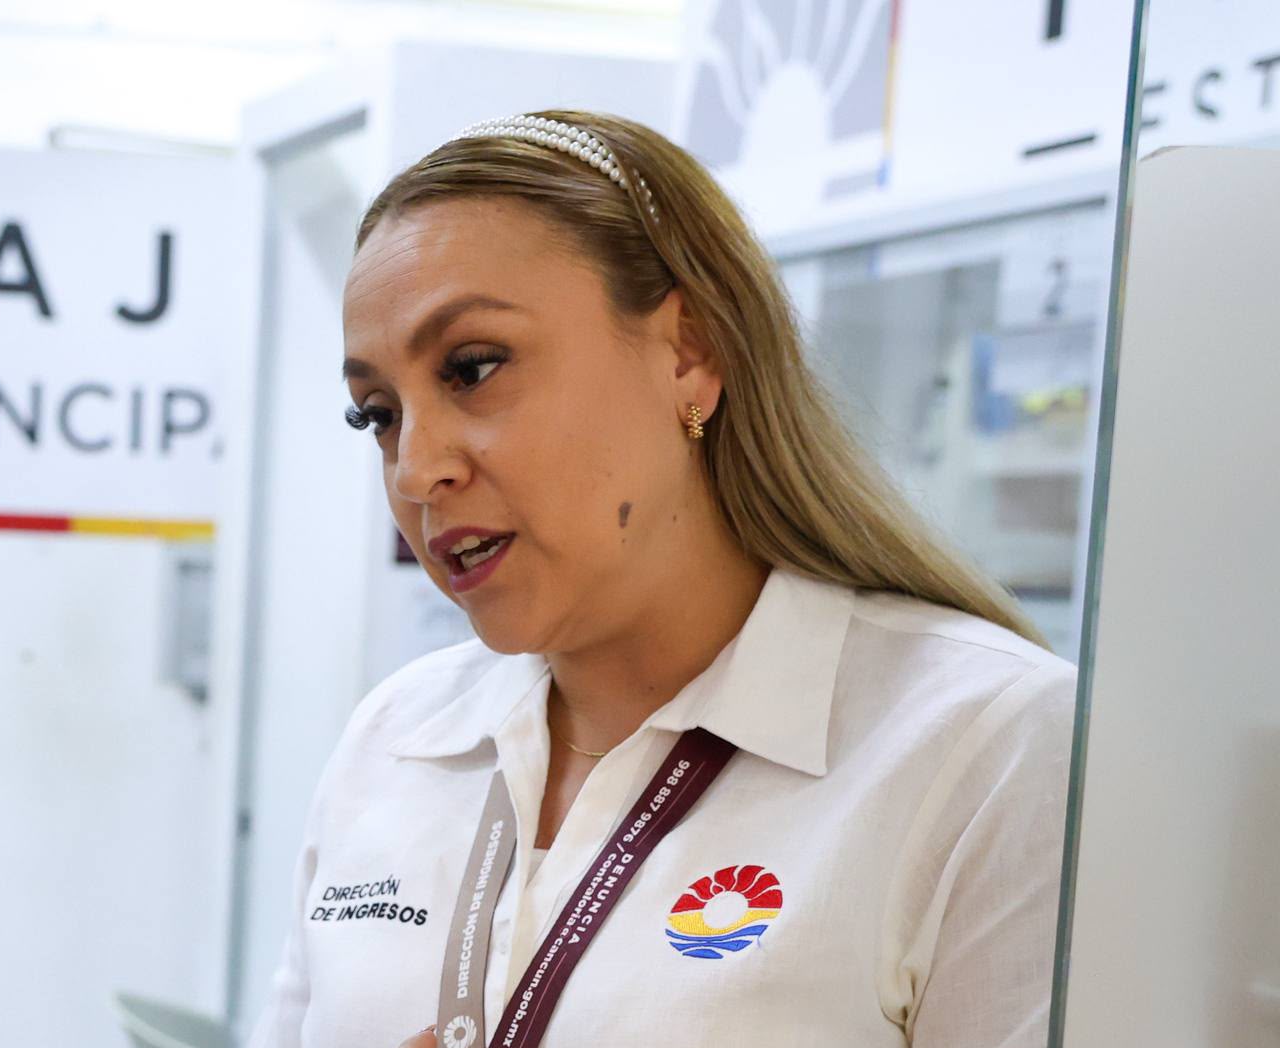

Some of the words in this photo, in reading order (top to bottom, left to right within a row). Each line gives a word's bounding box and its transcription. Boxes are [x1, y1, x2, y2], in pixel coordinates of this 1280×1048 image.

[666, 759, 691, 786] 998
[649, 786, 672, 812] 887
[622, 811, 652, 843] 9876
[476, 820, 504, 890] INGRESOS
[322, 873, 401, 901] DIRECCIÓN
[568, 852, 634, 945] DENUNCIA
[310, 906, 337, 921] DE
[336, 902, 429, 926] INGRESOS
[470, 890, 485, 914] DE
[457, 912, 479, 999] DIRECCIÓN
